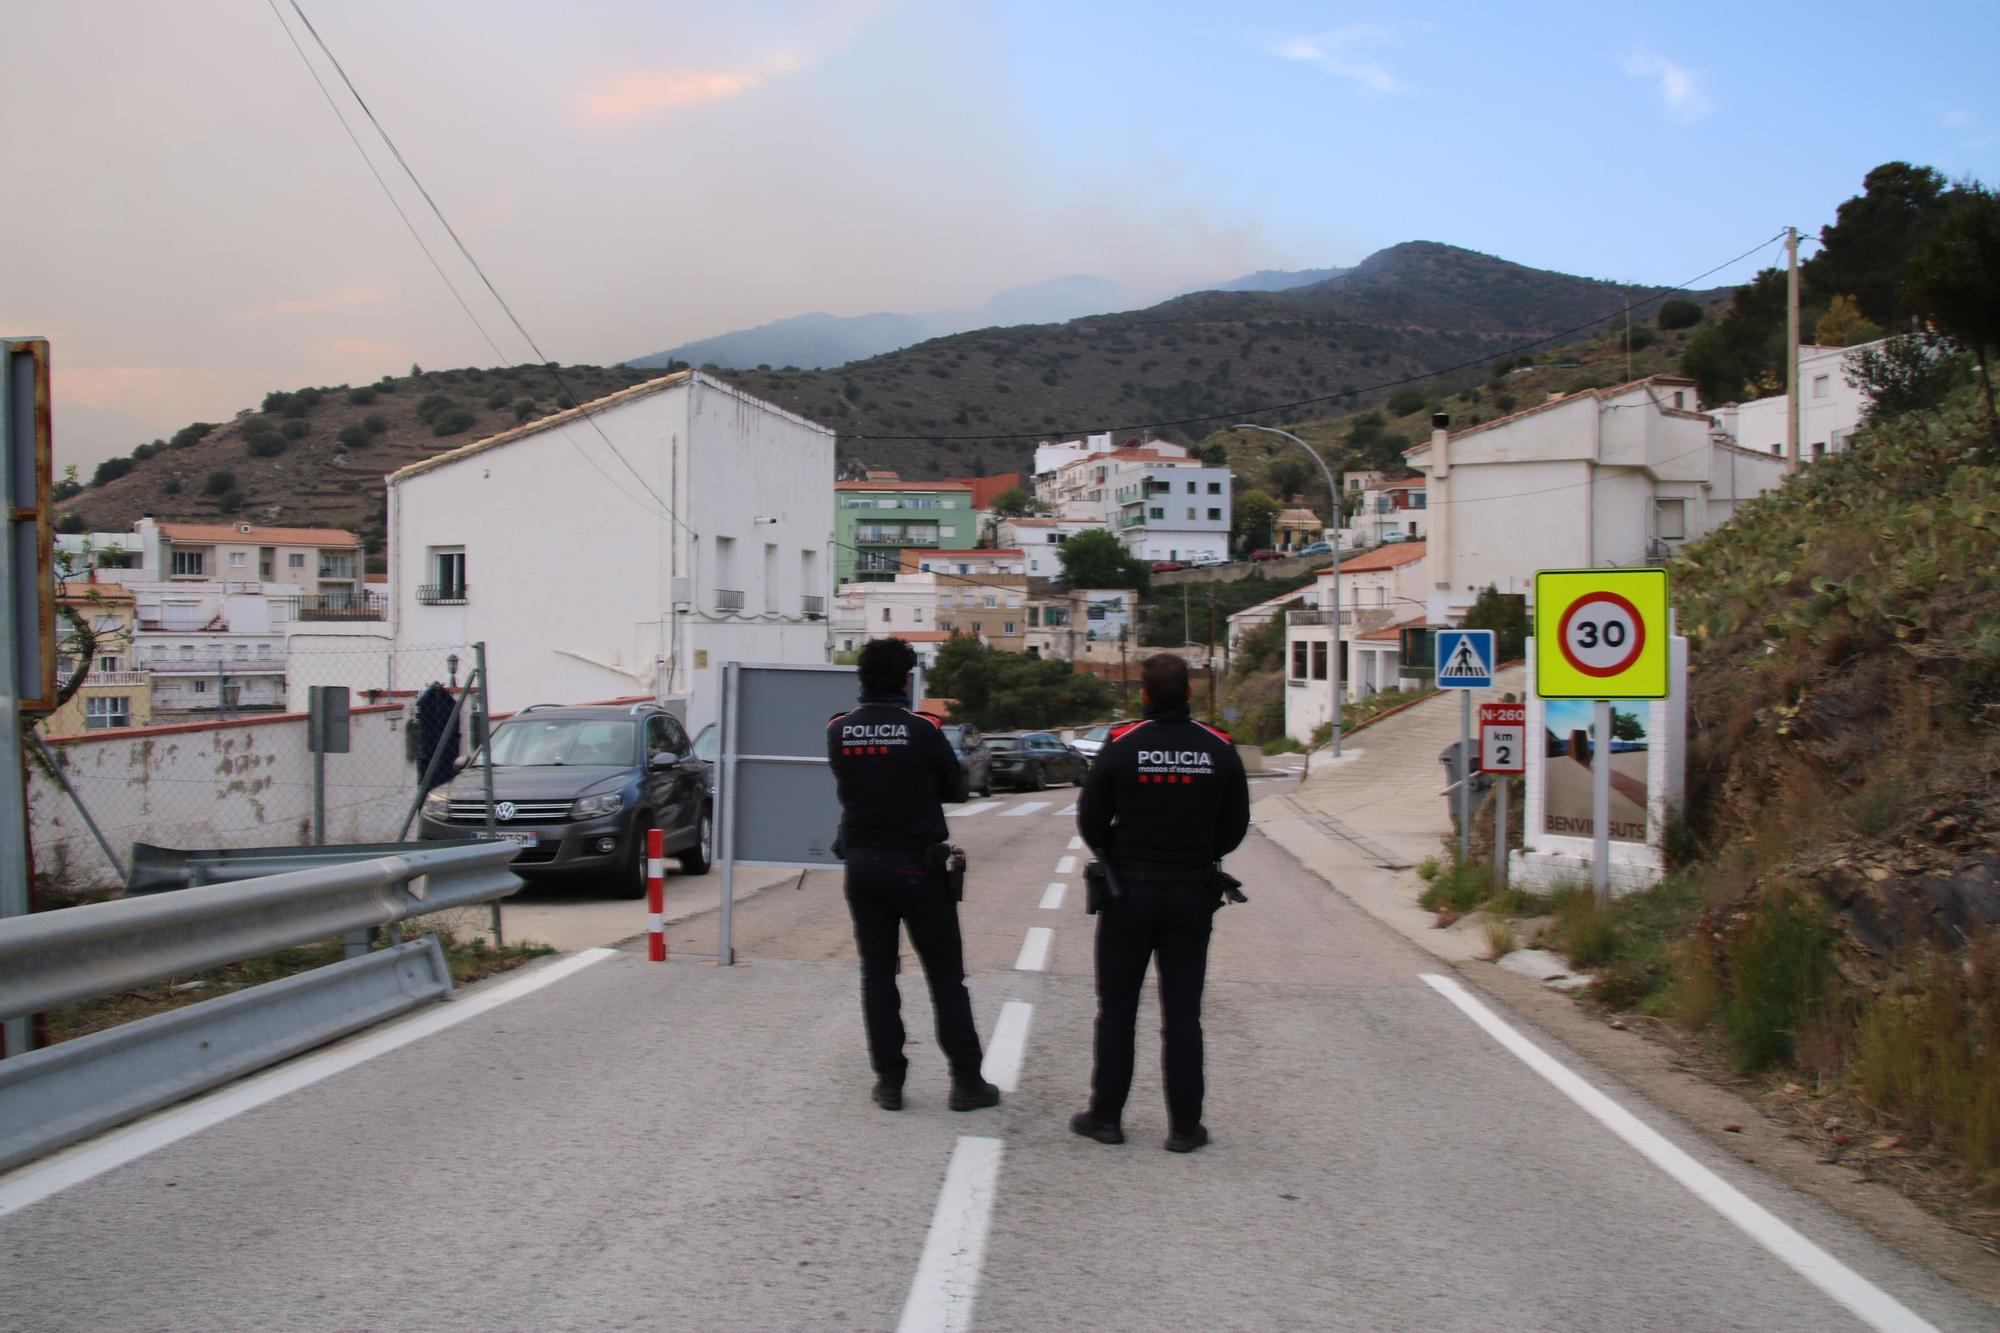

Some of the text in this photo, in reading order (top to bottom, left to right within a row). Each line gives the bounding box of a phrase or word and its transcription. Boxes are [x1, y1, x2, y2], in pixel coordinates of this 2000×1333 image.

[1577, 620, 1625, 648] 30
[1481, 709, 1525, 721] N-260
[842, 724, 908, 738] POLICIA
[1493, 731, 1513, 741] km
[1137, 751, 1212, 766] POLICIA
[1495, 746, 1511, 764] 2
[1169, 765, 1212, 775] d'esquadra
[1545, 815, 1645, 839] BENVIGUTS
